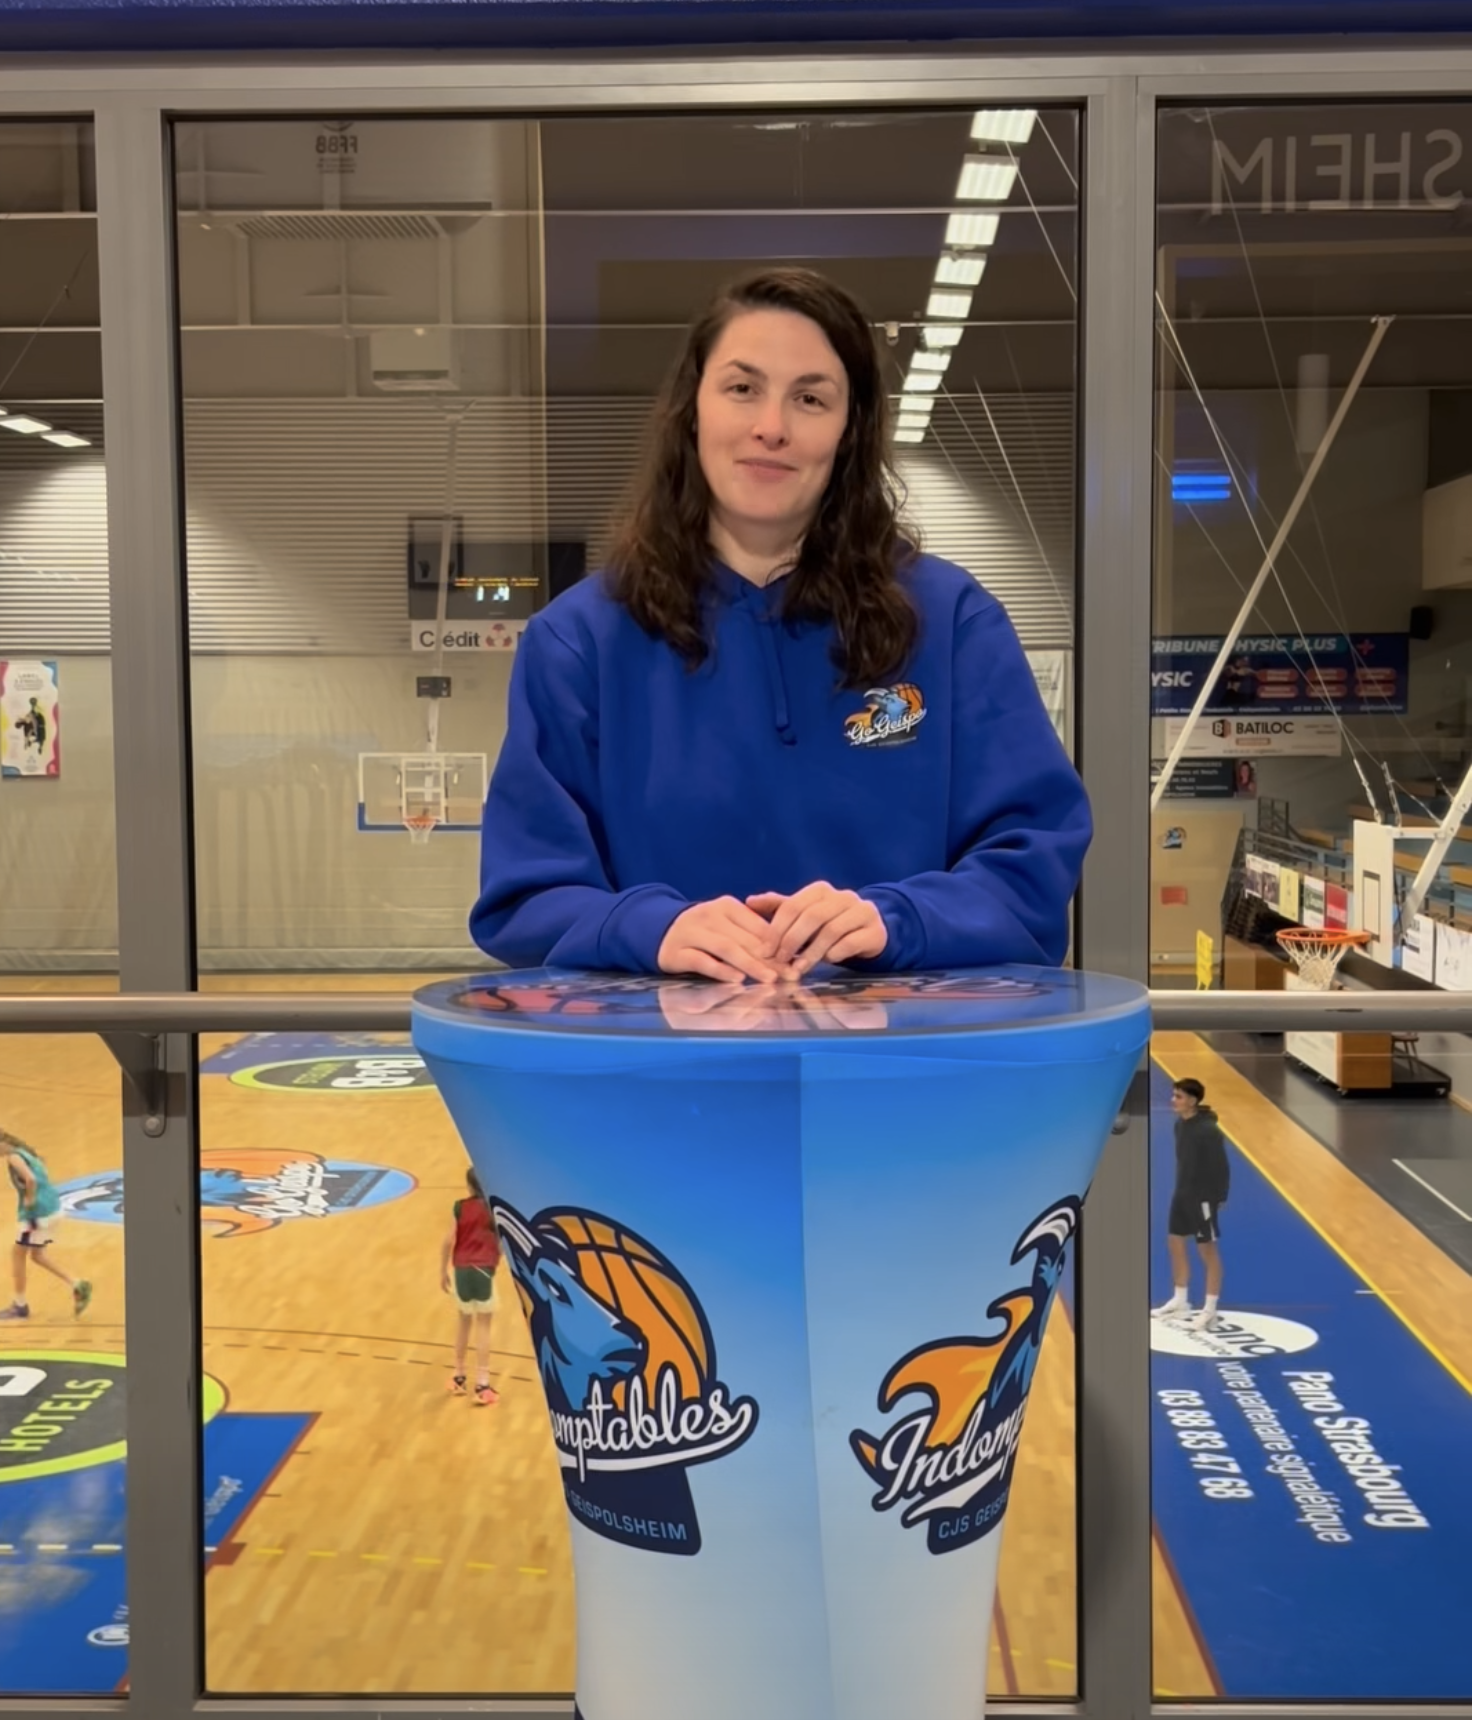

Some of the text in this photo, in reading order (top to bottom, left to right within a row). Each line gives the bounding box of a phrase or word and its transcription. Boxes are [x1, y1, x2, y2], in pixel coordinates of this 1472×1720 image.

[419, 630, 481, 648] Cédit
[1235, 638, 1288, 652] HYSIC
[1292, 638, 1337, 651] PLUS
[1236, 722, 1294, 735] BATILOC
[1157, 1390, 1204, 1406] 03
[0, 1378, 114, 1452] HOTELS
[1166, 1409, 1216, 1427] 88
[1177, 1430, 1228, 1449] 83
[1281, 1371, 1430, 1528] Pano Strasbourg
[1216, 1361, 1352, 1543] votre partenaire signalétique
[1189, 1452, 1242, 1473] 47
[1199, 1477, 1254, 1498] 68
[938, 1515, 970, 1539] CJS
